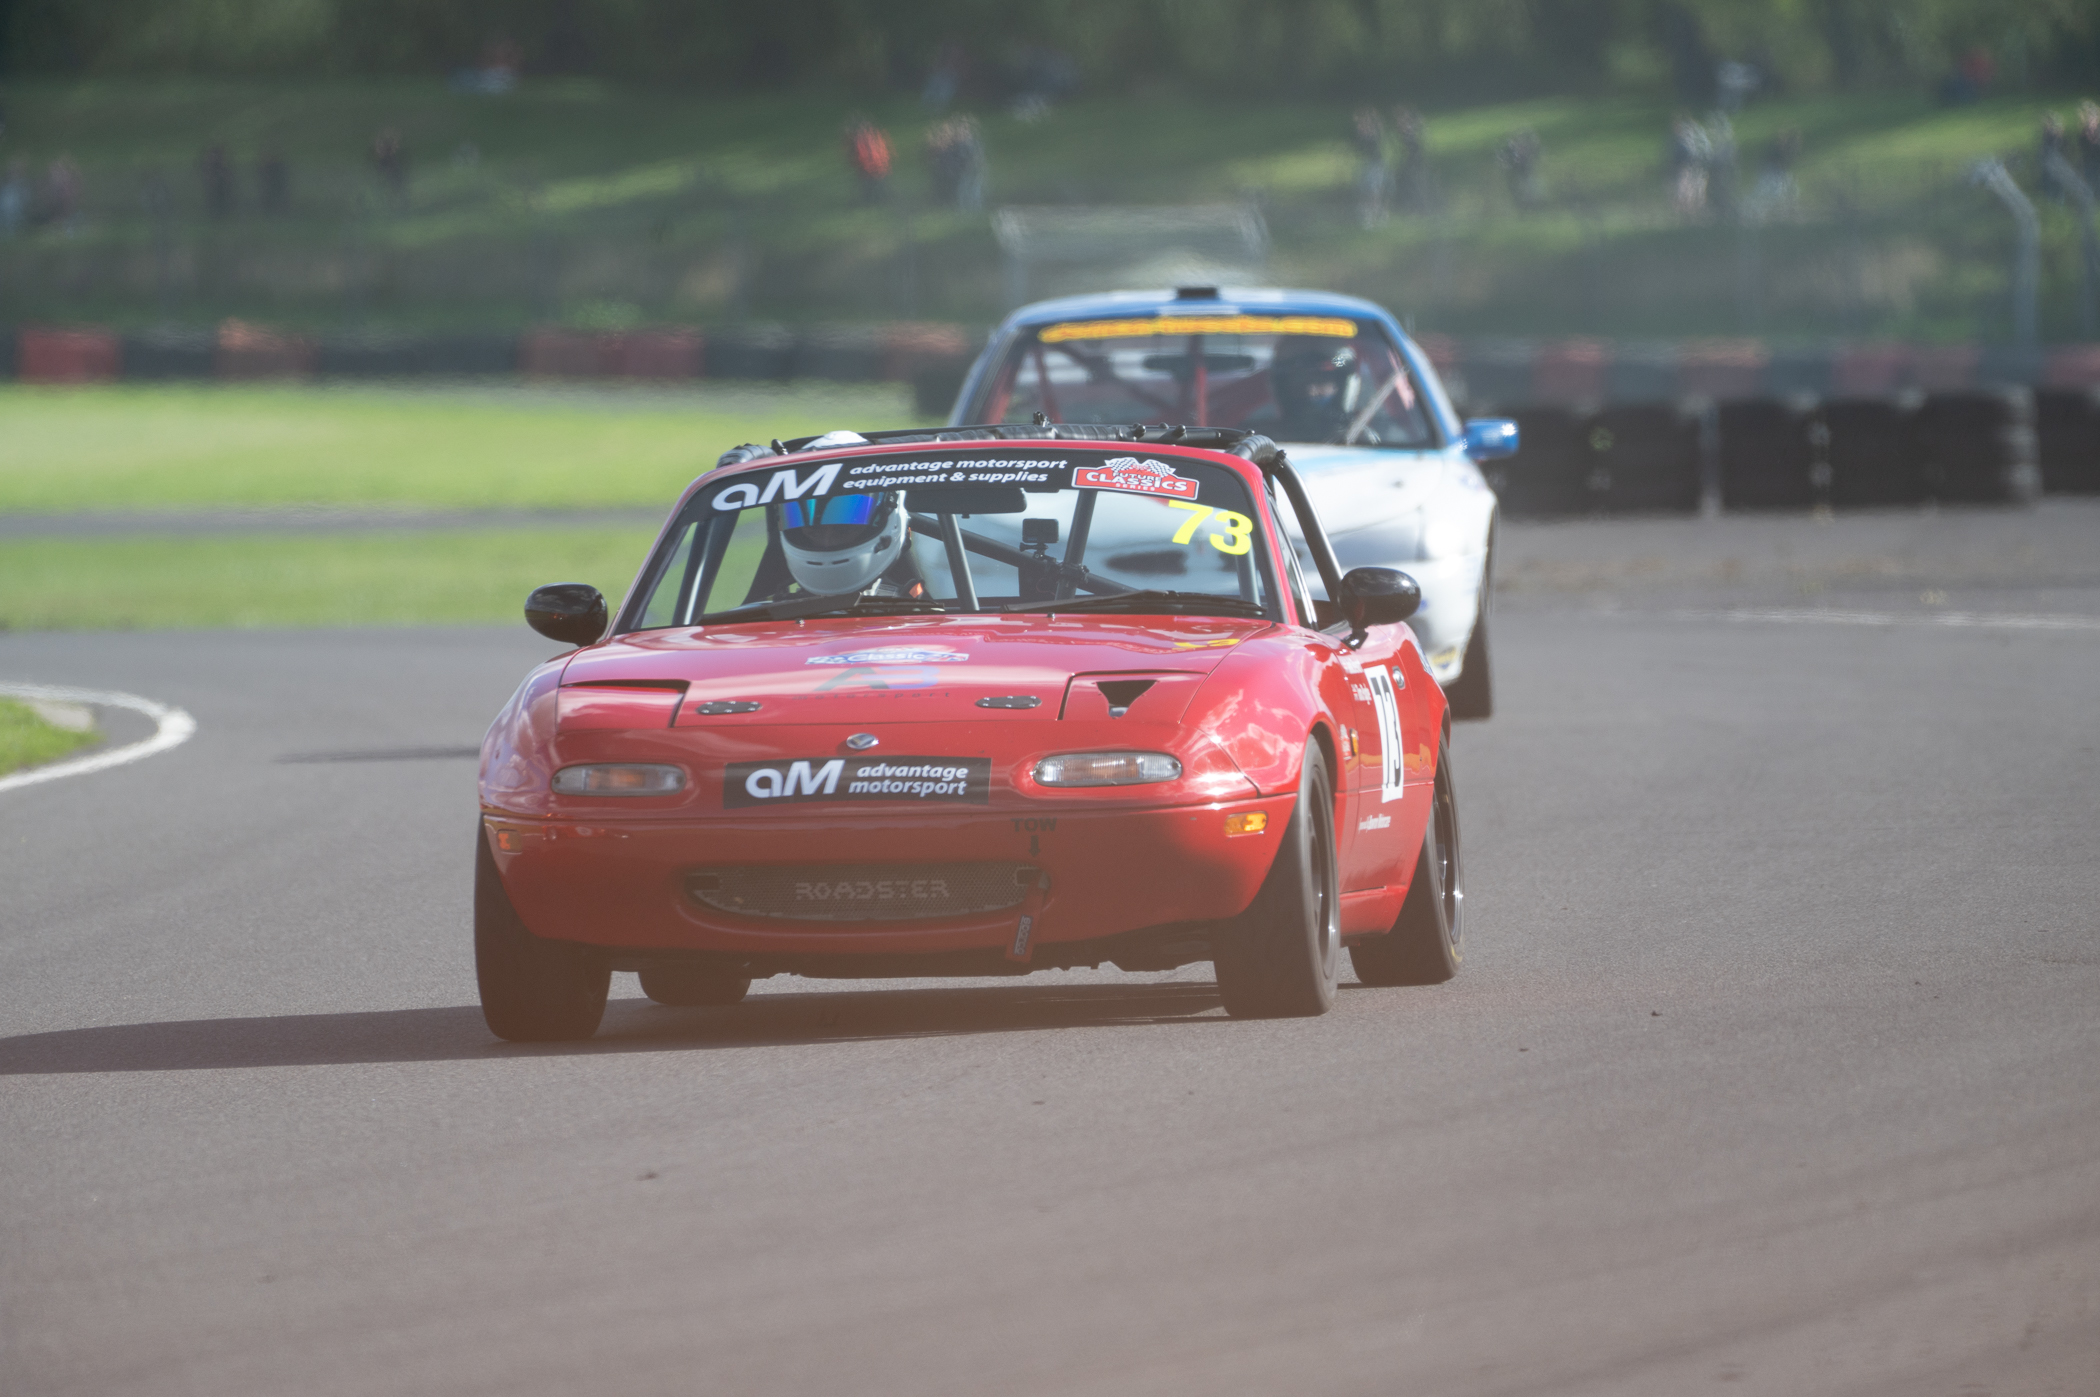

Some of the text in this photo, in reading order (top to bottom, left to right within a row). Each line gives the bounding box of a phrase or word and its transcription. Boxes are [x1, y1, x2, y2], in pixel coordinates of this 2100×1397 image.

[850, 459, 1067, 475] advantage motorsport
[843, 471, 1048, 488] equipment & supplies
[1086, 471, 1188, 492] CLASSICS
[1112, 472, 1162, 482] FUTURE
[711, 463, 843, 511] aM
[1115, 482, 1156, 492] SERIES
[1168, 500, 1253, 555] 73
[848, 652, 925, 662] Classic
[1370, 675, 1401, 788] 73
[745, 759, 845, 798] aM
[857, 763, 968, 781] advantage
[848, 779, 967, 797] motorsport
[1011, 818, 1057, 832] TOW
[796, 880, 950, 900] ROADSTER
